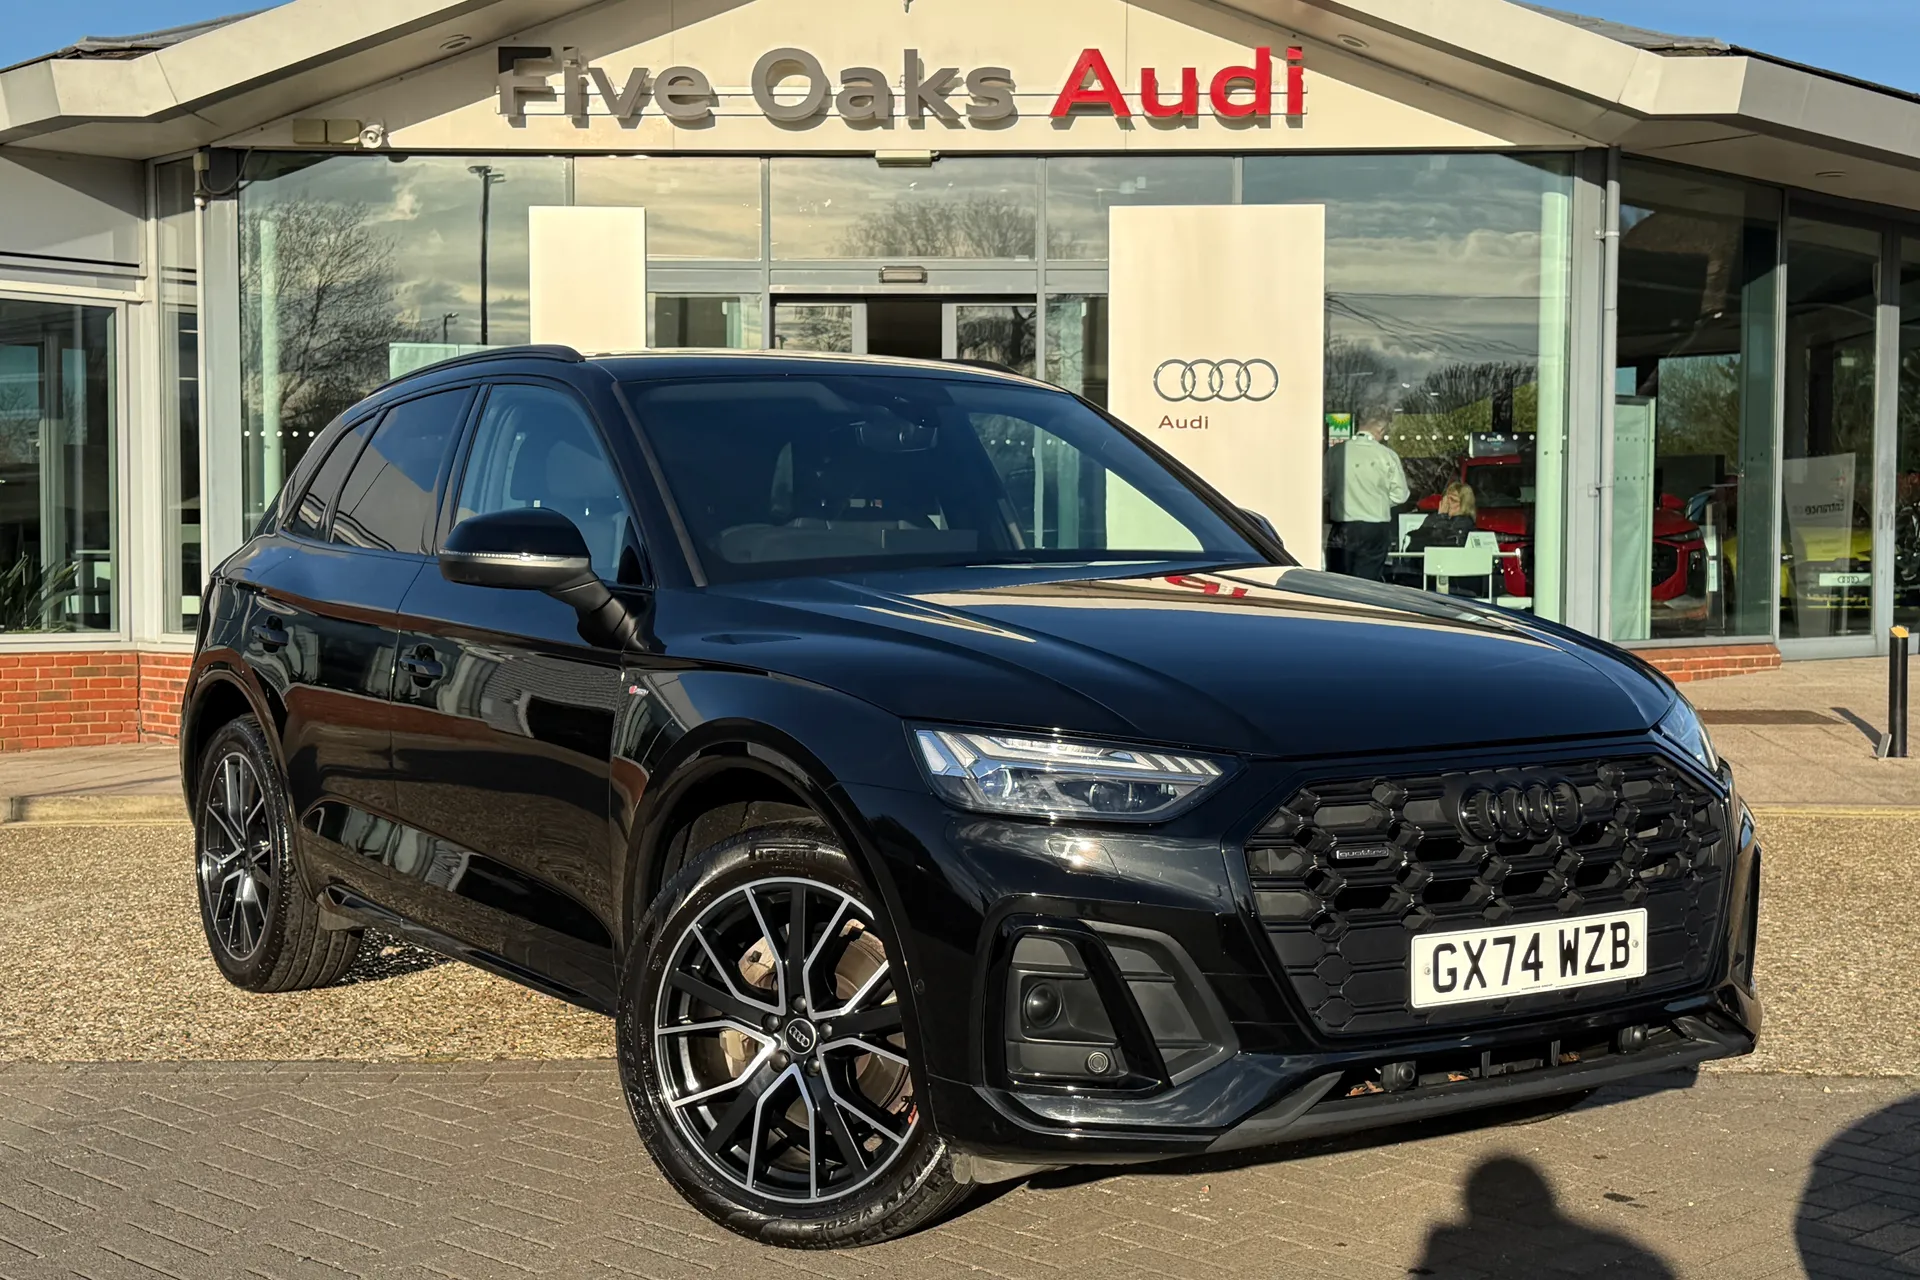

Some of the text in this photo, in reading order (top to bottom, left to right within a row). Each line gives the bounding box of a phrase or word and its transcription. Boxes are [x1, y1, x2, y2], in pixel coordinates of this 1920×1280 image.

[497, 46, 1305, 121] Five Oaks Audi
[1158, 415, 1209, 430] Audi
[1432, 920, 1630, 994] GX74 WZB
